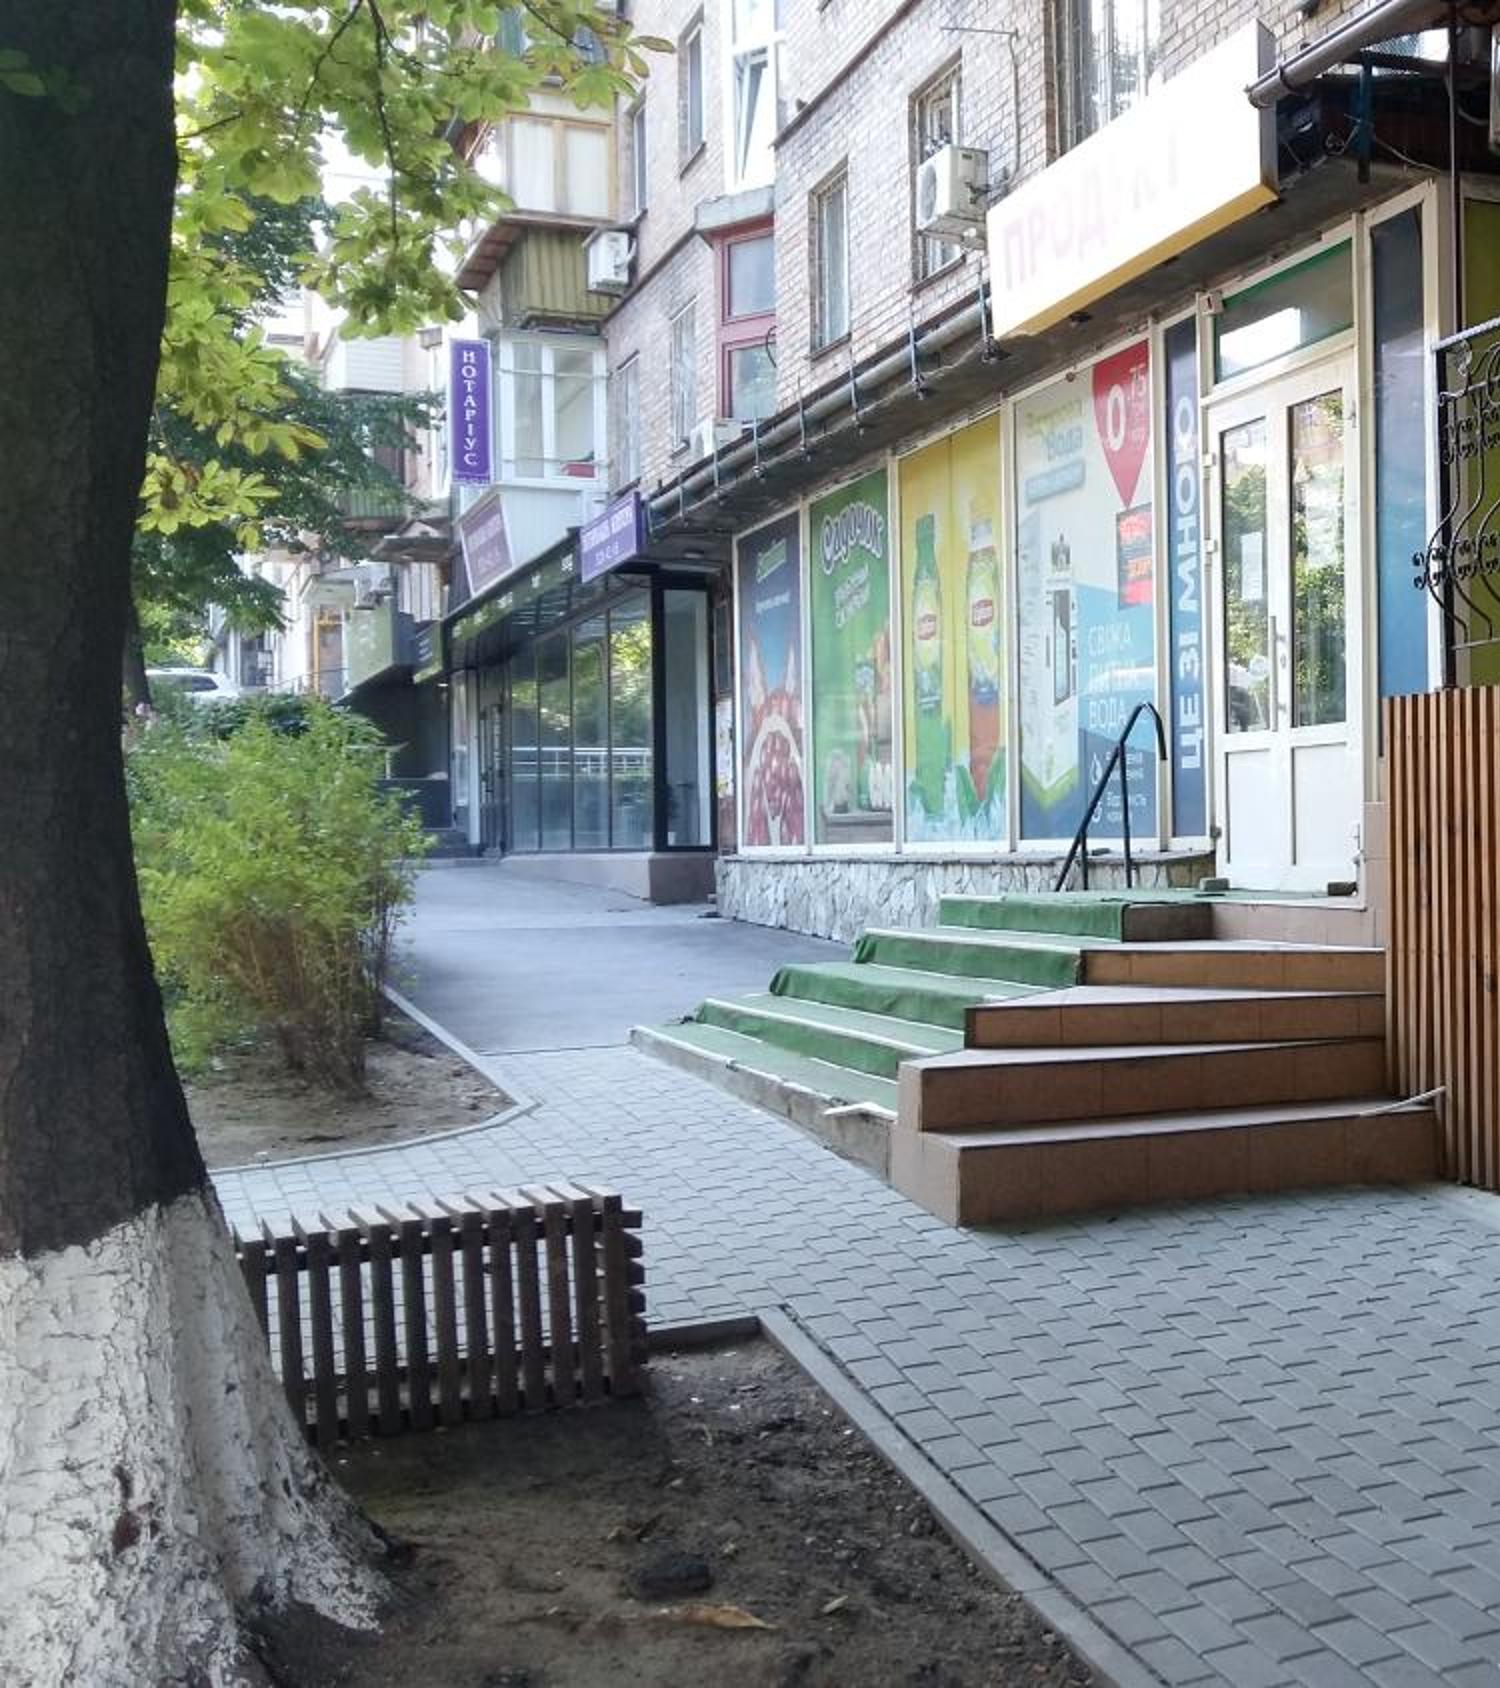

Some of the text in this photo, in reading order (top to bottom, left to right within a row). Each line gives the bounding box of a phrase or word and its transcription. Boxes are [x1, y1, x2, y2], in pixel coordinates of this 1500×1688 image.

[461, 351, 477, 465] НОТАРІУС
[1174, 396, 1203, 769] ЦЕ ЗІ МНОЮ
